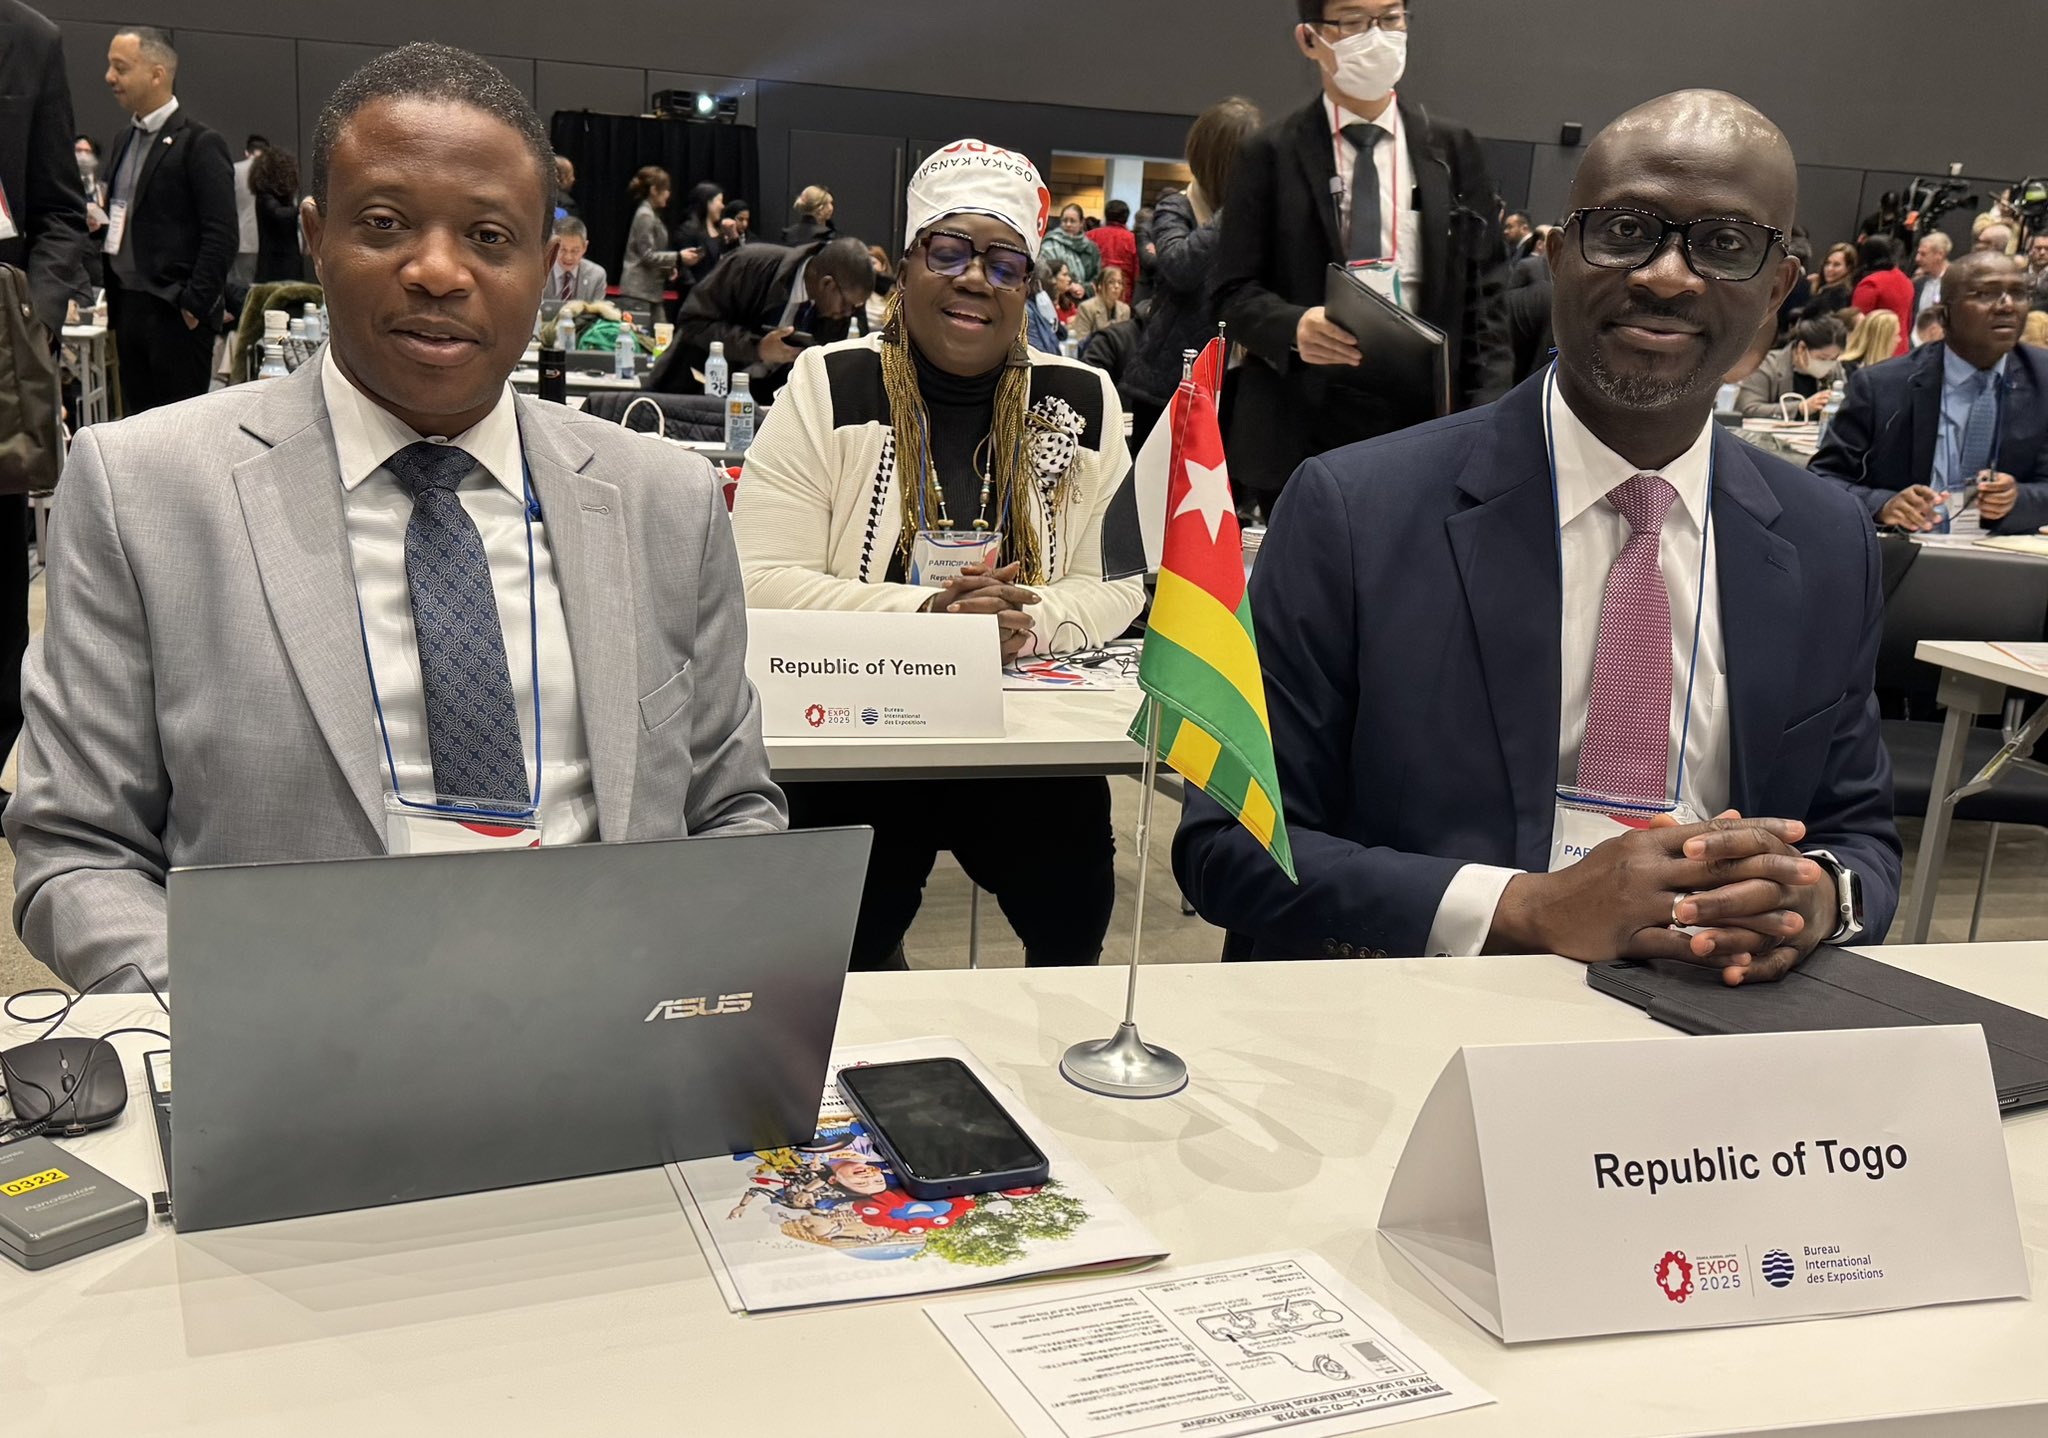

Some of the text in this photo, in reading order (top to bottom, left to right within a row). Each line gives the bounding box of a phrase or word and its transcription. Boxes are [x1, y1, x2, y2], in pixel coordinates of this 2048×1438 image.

[770, 657, 956, 678] Republic of Yemen
[643, 992, 753, 1022] ASUS
[1594, 1139, 1908, 1195] Republic of Togo
[7, 1171, 63, 1193] 0322
[1803, 1245, 1841, 1256] Bureau
[1697, 1258, 1739, 1276] EXPO
[1805, 1254, 1872, 1270] International
[1700, 1274, 1741, 1291] 2025
[1807, 1269, 1884, 1284] des Expositions
